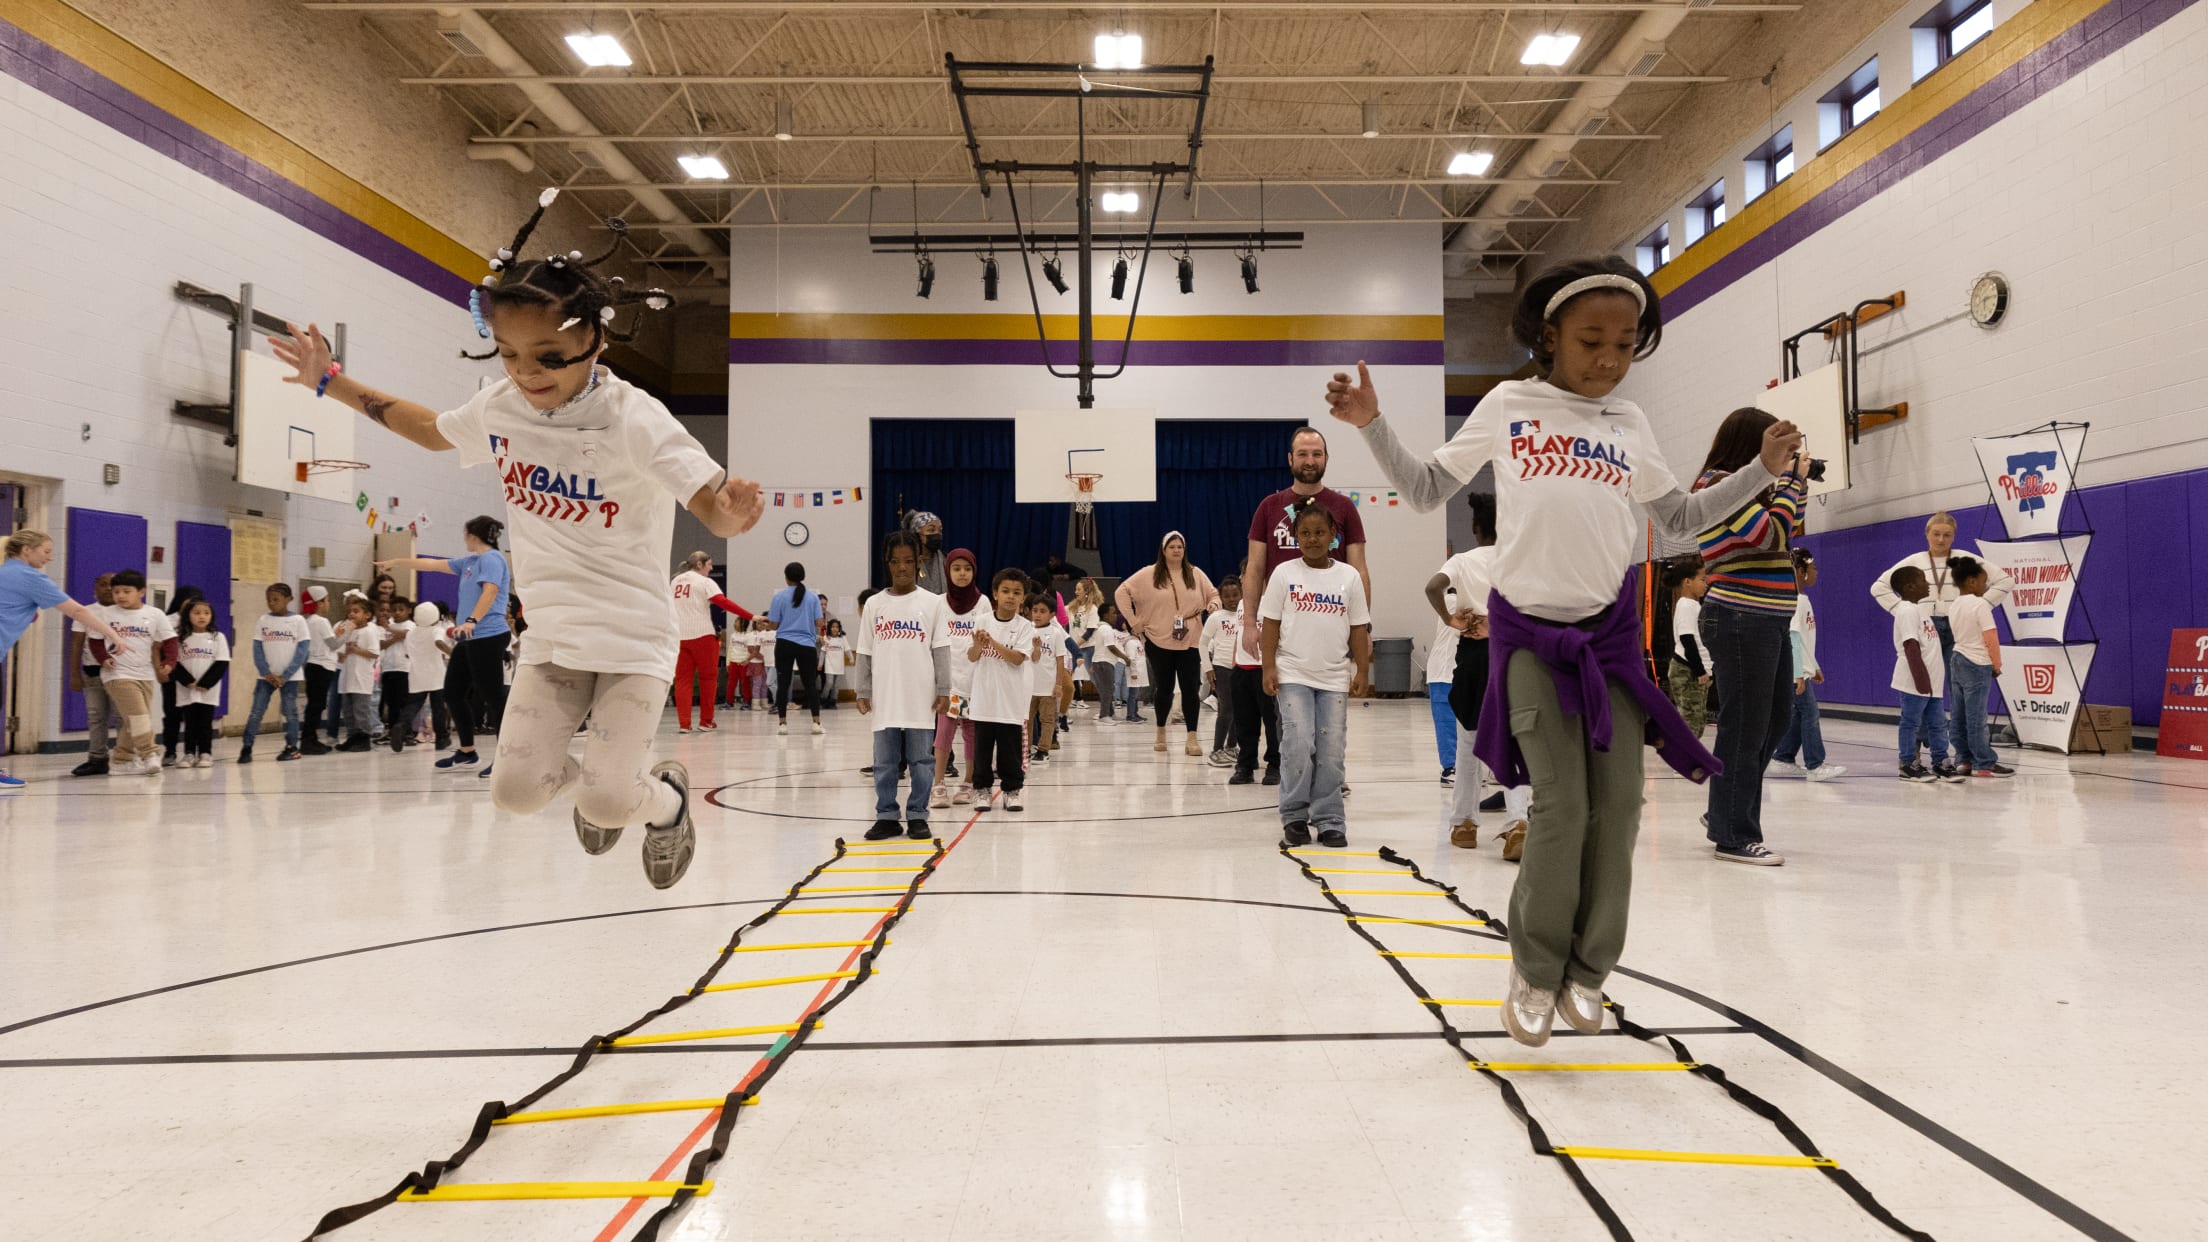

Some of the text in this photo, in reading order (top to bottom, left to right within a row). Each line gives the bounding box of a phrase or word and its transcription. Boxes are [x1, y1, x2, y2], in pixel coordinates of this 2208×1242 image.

[1511, 435, 1630, 471] PLAYBALL
[1998, 475, 2058, 501] Phillies
[599, 501, 619, 528] P
[2021, 566, 2037, 584] AND
[2039, 563, 2073, 583] WOMEN
[674, 583, 690, 598] 24
[1290, 592, 1343, 605] PLAYBALL
[2020, 588, 2044, 606] SPORTS
[2043, 587, 2060, 605] DAY
[875, 620, 922, 634] PLAYBALL
[2013, 699, 2070, 715] LF Driscoll
